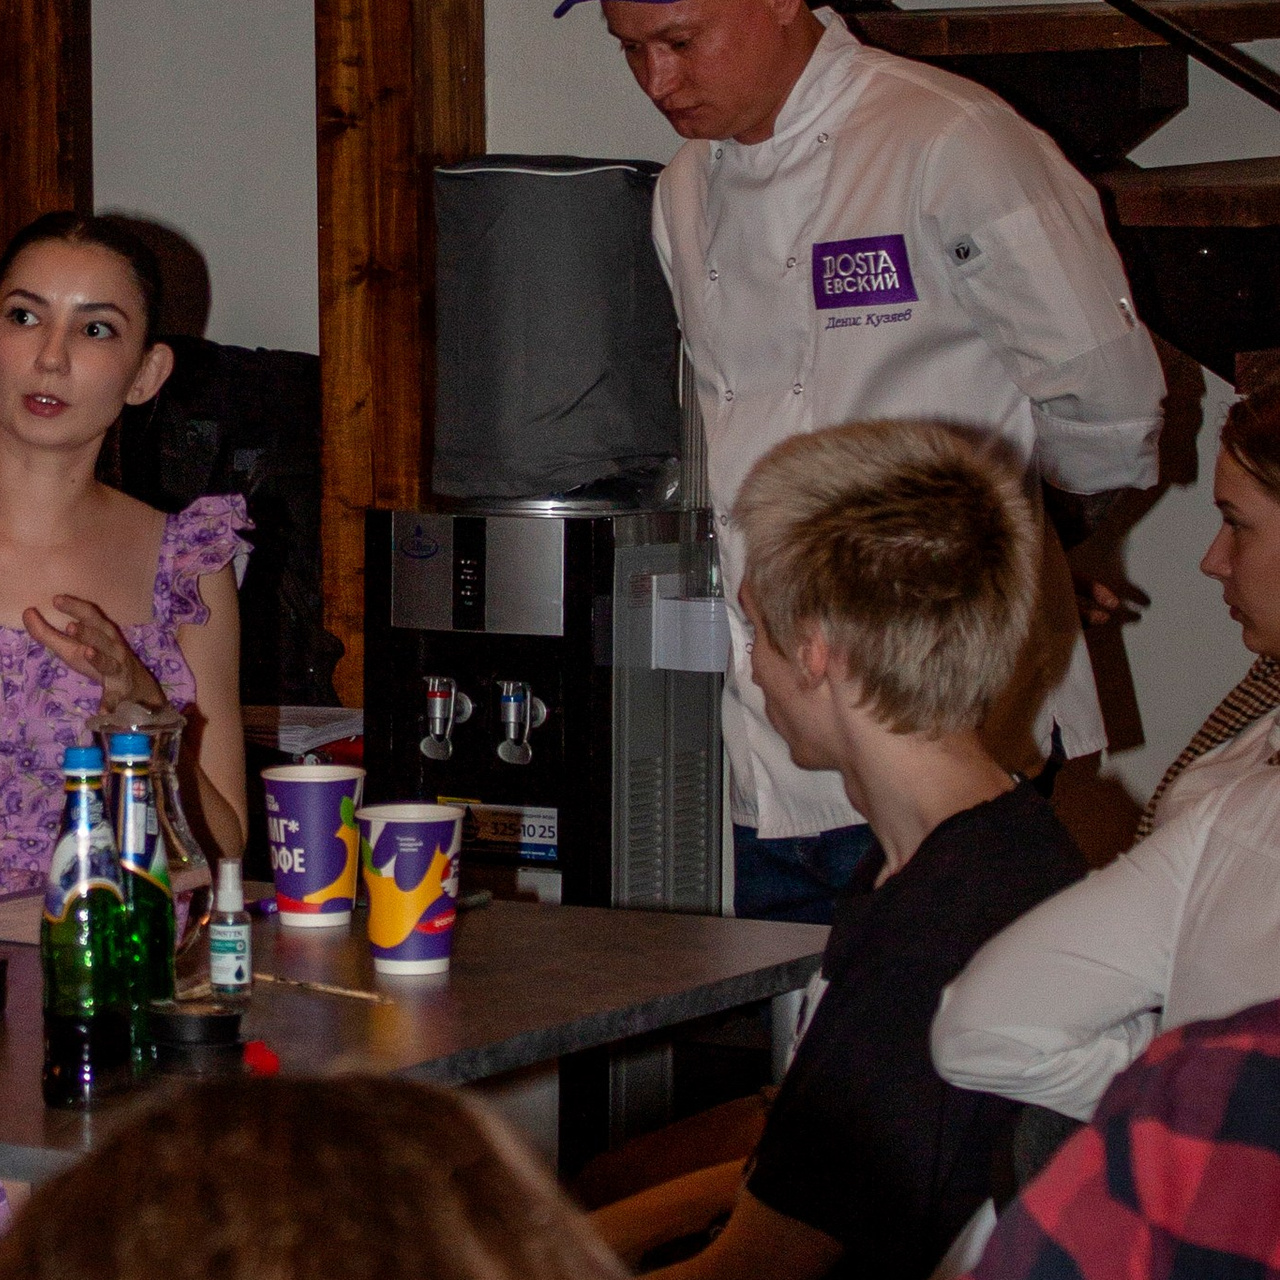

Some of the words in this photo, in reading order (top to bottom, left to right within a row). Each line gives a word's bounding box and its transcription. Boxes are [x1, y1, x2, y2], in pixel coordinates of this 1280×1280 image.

[825, 272, 900, 294] ЕВСКИЙ
[825, 315, 861, 330] Денис
[865, 308, 913, 328] Кузяев
[538, 824, 555, 839] 25
[270, 845, 306, 874] ОФЕ
